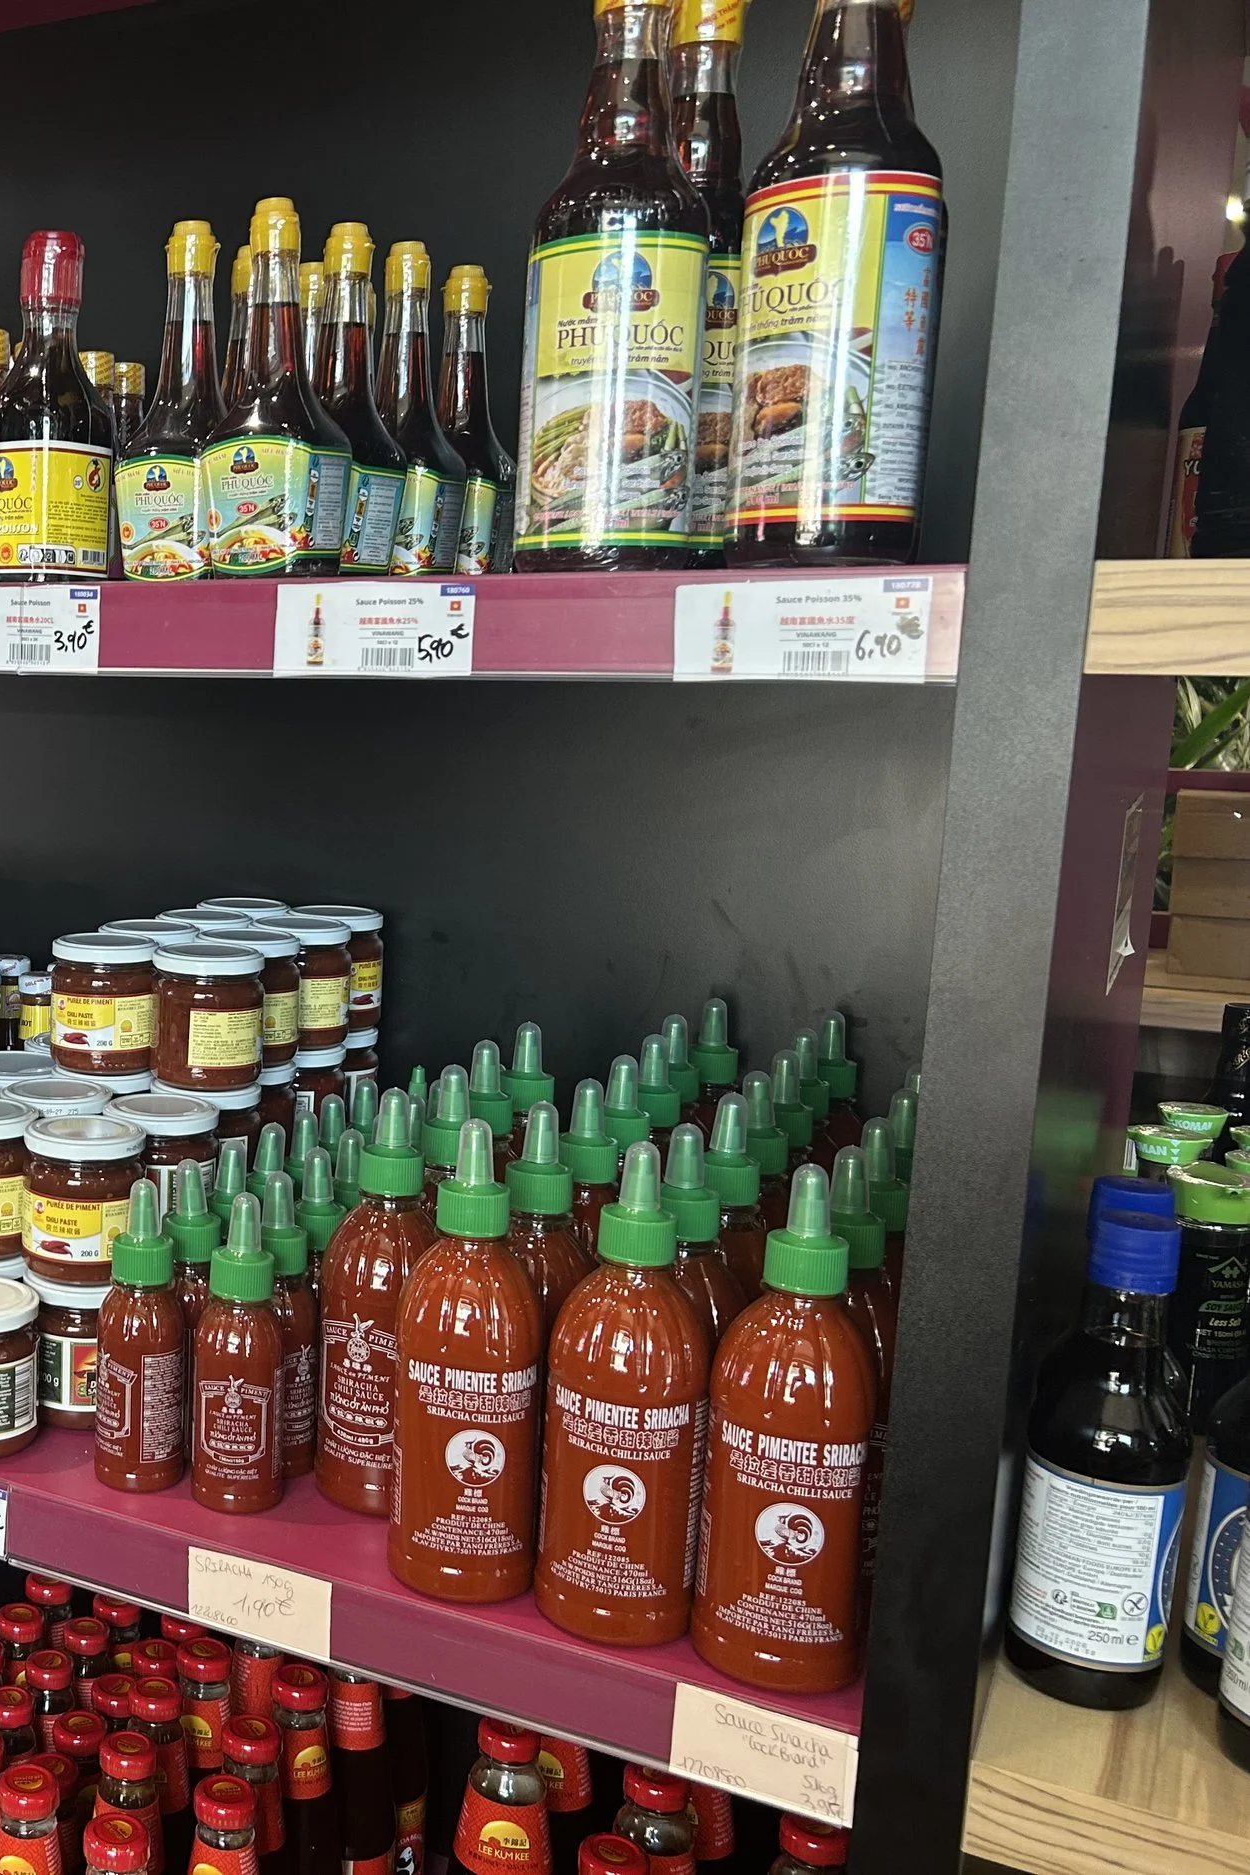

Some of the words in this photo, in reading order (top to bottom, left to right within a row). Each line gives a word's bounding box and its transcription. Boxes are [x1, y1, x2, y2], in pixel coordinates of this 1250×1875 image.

[1209, 1318, 1227, 1326] Less
[327, 1326, 347, 1336] SAUCE
[338, 1375, 378, 1392] SRIRACHA
[409, 1359, 440, 1386] SAUCE
[445, 1368, 497, 1393] PIMENTEE
[241, 1388, 265, 1396] PIMENT
[334, 1384, 353, 1396] CHILI
[356, 1390, 384, 1401] SAUCE
[427, 1405, 471, 1421] SRIRACHA
[473, 1415, 500, 1423] CHILLI
[502, 1412, 525, 1423] SAUCE
[556, 1384, 581, 1415] SAUCE
[585, 1397, 639, 1429] PIMENTEE
[644, 1403, 690, 1430] SRIRACHA
[217, 1419, 248, 1427] SRIRACHA
[568, 1434, 609, 1456] SRIRACHA
[611, 1448, 643, 1460] CHILLI
[644, 1450, 671, 1460] SAUCE
[722, 1420, 753, 1452] SAUCE
[758, 1434, 817, 1464] PIMENTEE
[737, 1473, 785, 1493] SRIRACHA
[787, 1486, 820, 1498] CHILLI
[823, 1488, 852, 1499] SAUCE
[195, 1555, 252, 1579] SRIRACHA
[572, 1550, 605, 1566] PRODUIT
[607, 1560, 617, 1568] DE
[619, 1562, 644, 1570] CHINE
[614, 1589, 637, 1597] PARIS
[1088, 1631, 1109, 1644] 250
[1112, 1633, 1124, 1645] ml
[715, 1704, 767, 1737] Sauce
[478, 1844, 492, 1855] LEE
[495, 1849, 513, 1860] KUM
[515, 1852, 529, 1860] KEE
